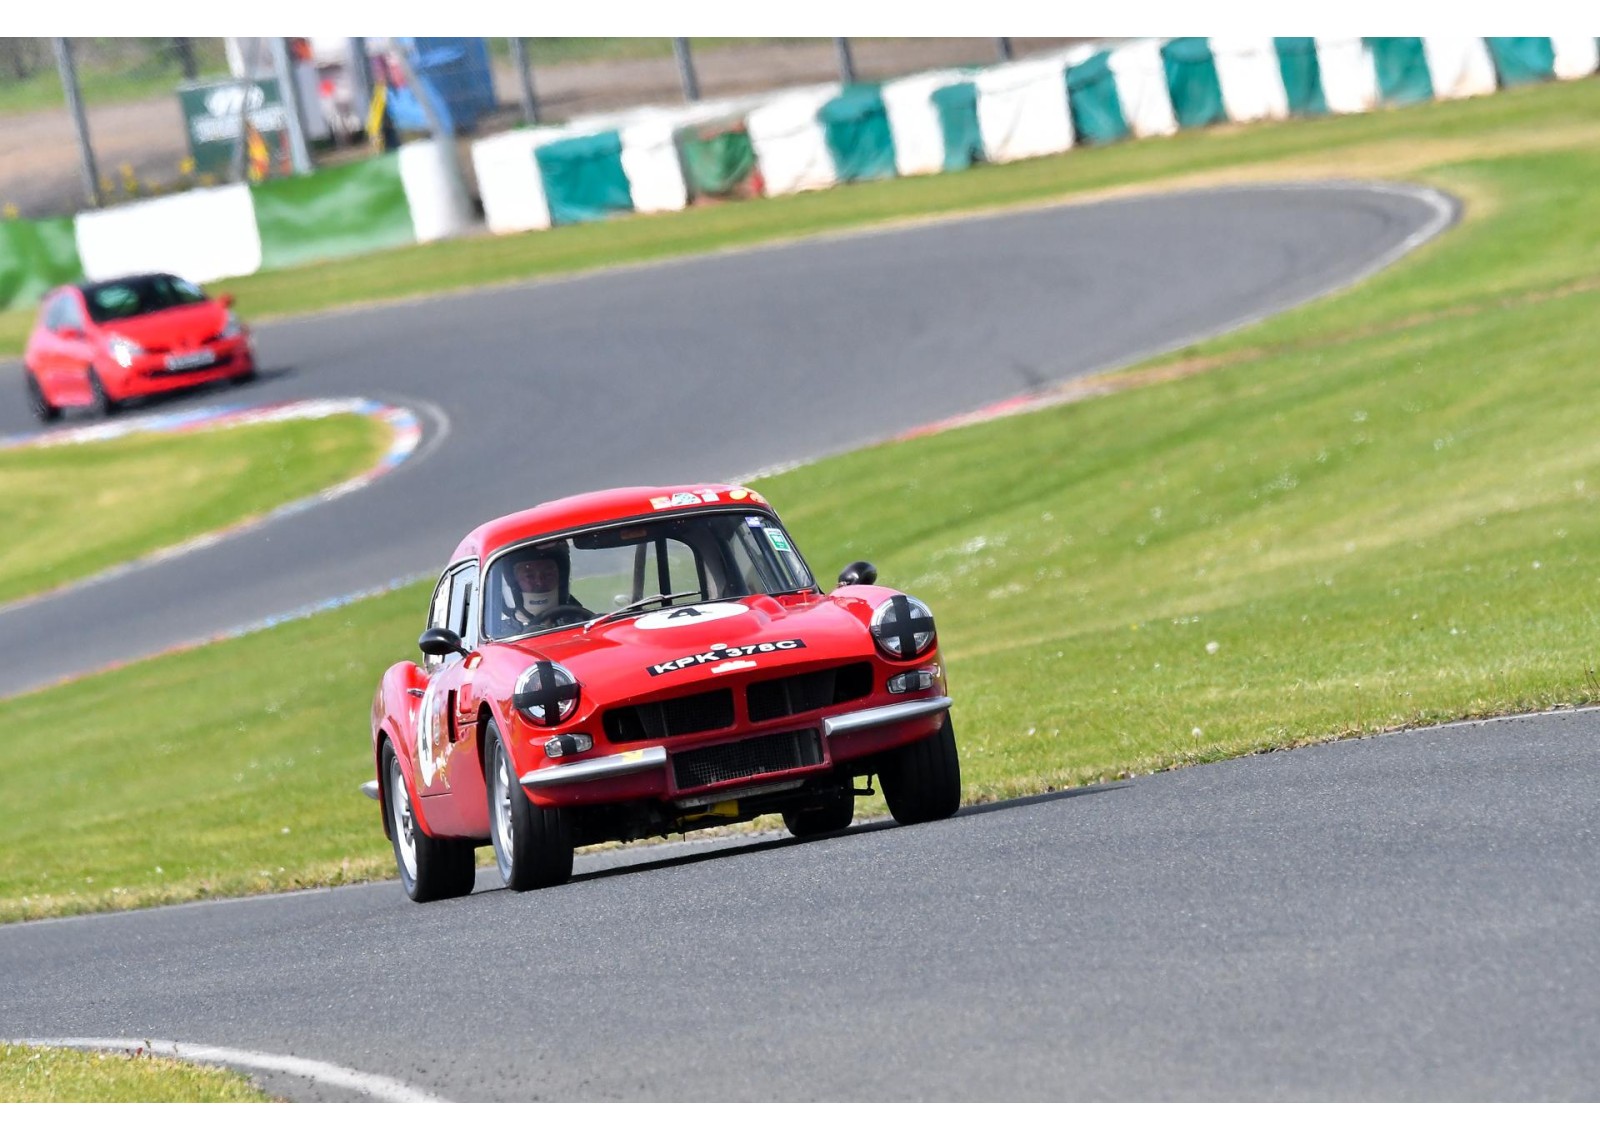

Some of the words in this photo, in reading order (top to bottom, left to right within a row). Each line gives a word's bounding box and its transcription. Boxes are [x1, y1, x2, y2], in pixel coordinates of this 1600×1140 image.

[667, 607, 706, 620] 4
[654, 652, 720, 674] KPK
[726, 640, 798, 657] 378C
